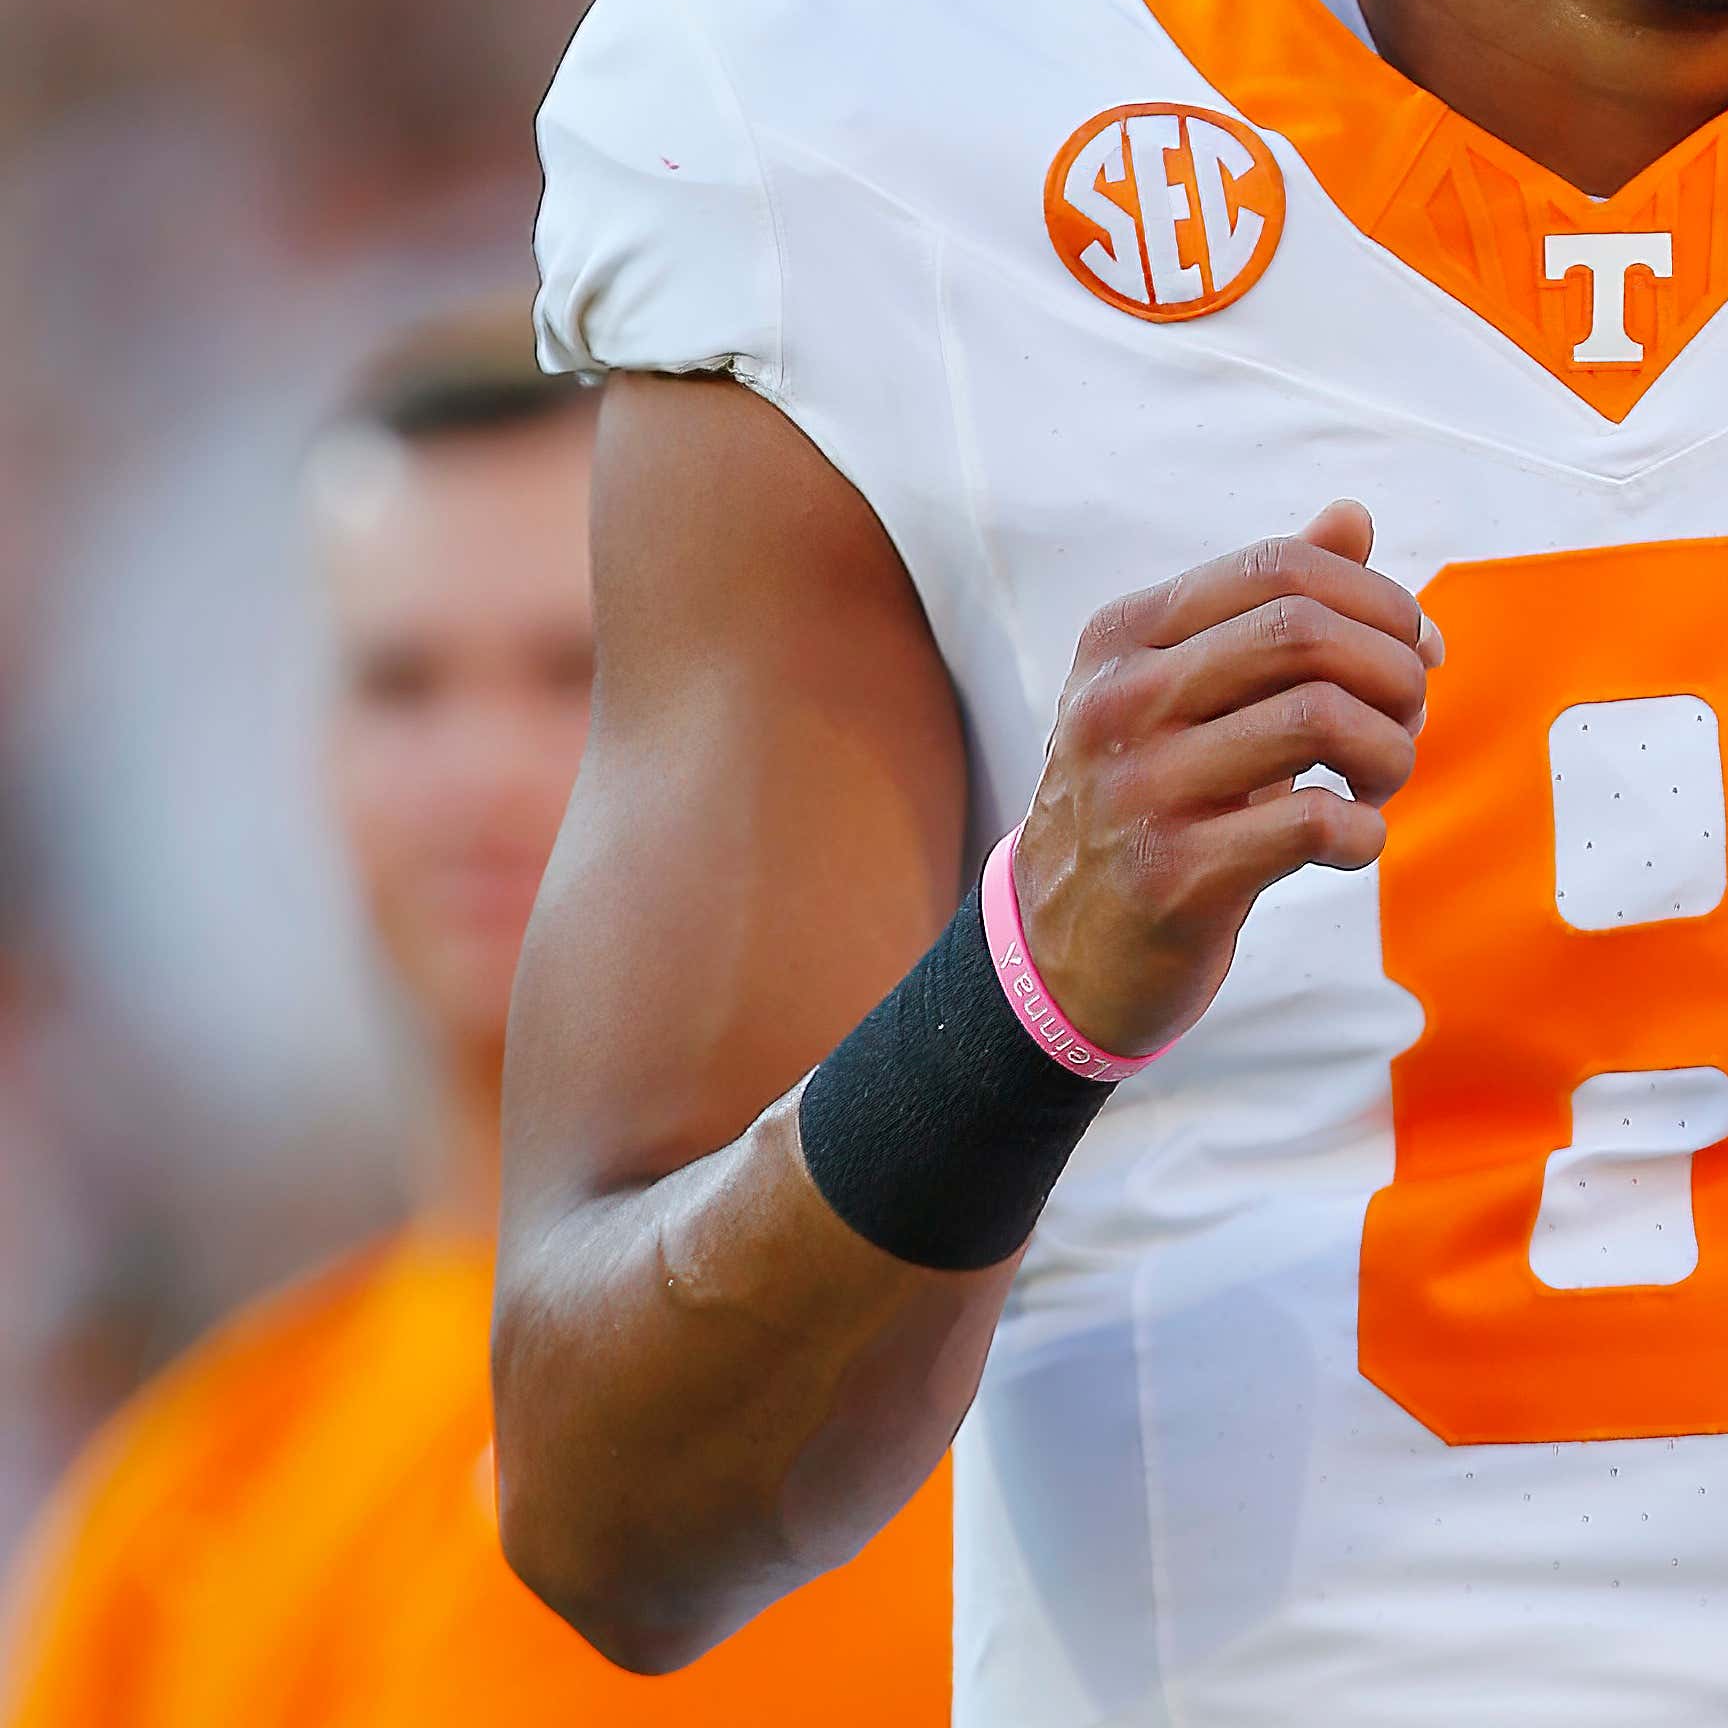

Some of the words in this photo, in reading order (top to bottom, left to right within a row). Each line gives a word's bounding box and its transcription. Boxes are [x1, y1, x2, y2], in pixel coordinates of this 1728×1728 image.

[1063, 113, 1265, 305] SEC
[1544, 232, 1673, 363] T
[1013, 973, 1112, 1079] Leinna
